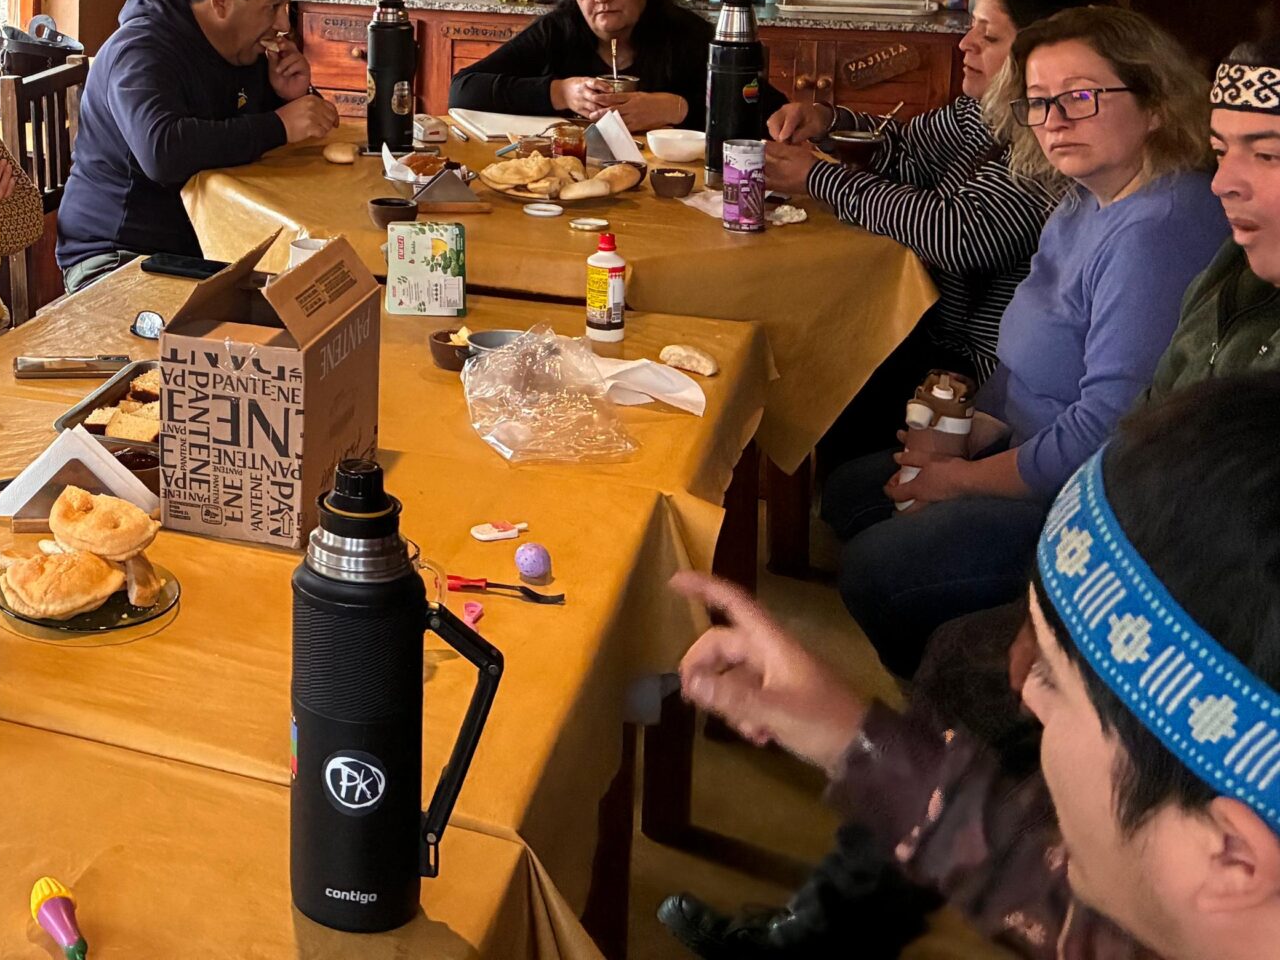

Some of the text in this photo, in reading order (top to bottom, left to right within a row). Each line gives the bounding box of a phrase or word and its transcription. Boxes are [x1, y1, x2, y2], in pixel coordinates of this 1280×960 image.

[848, 44, 908, 72] VAJILLA
[319, 304, 372, 381] PANTENE
[188, 370, 211, 493] PANTENE
[212, 447, 303, 481] PANTENE
[212, 464, 243, 476] PANTENE
[162, 487, 211, 504] PANTENE
[325, 887, 378, 904] contigo
